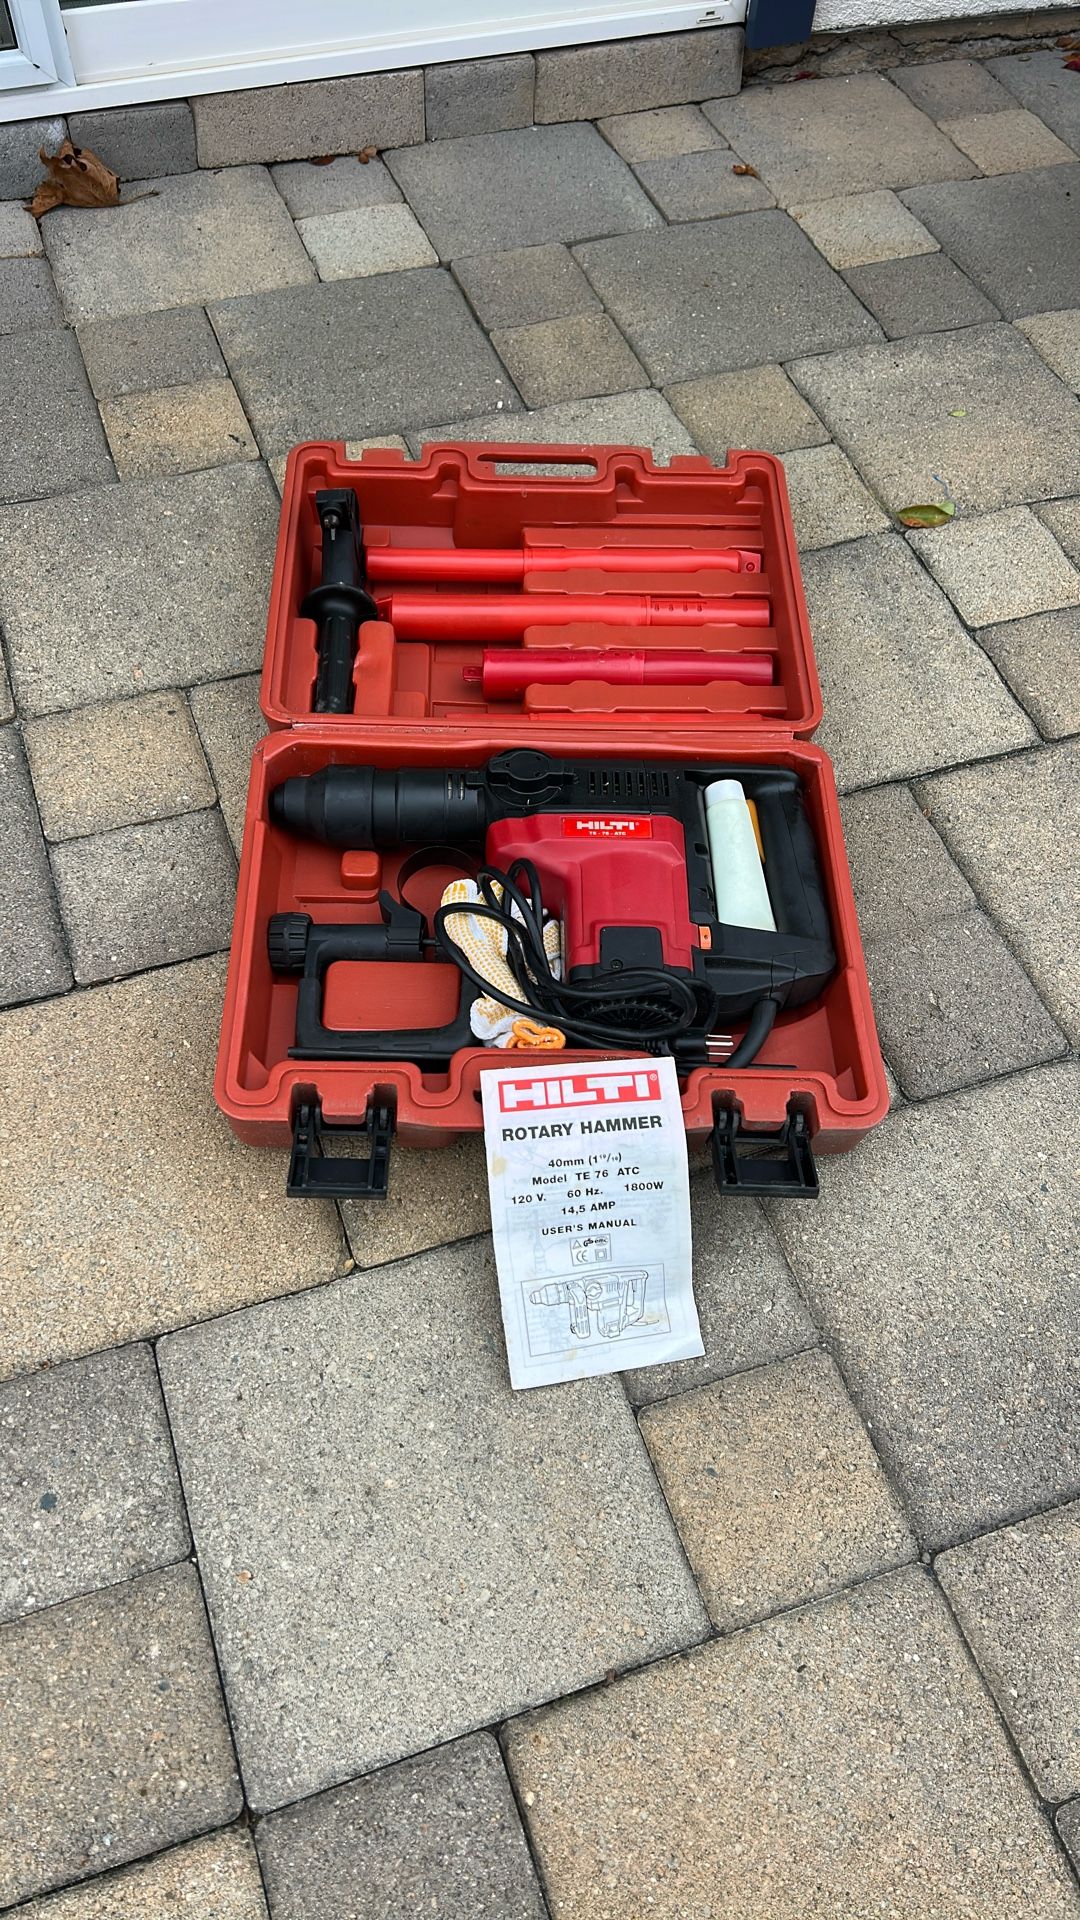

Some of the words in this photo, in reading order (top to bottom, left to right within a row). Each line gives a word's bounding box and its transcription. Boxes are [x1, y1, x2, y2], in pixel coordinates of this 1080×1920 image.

[576, 821, 635, 830] HILTI
[503, 1074, 650, 1108] HILTI
[502, 1123, 573, 1142] ROTARY
[581, 1115, 662, 1134] HAMMER
[548, 1158, 584, 1168] 40mm
[532, 1174, 568, 1186] Model
[575, 1172, 590, 1181] TE
[595, 1170, 609, 1179] 76
[617, 1166, 640, 1176] ATC
[511, 1194, 532, 1205] 120
[536, 1193, 547, 1202] V.
[567, 1189, 582, 1199] 60
[585, 1187, 603, 1197] Hz.
[624, 1181, 664, 1192] 1800W
[561, 1205, 586, 1216] 14,5
[590, 1201, 616, 1212] AMP
[542, 1225, 584, 1236] USER'S
[588, 1219, 637, 1231] MANUAL
